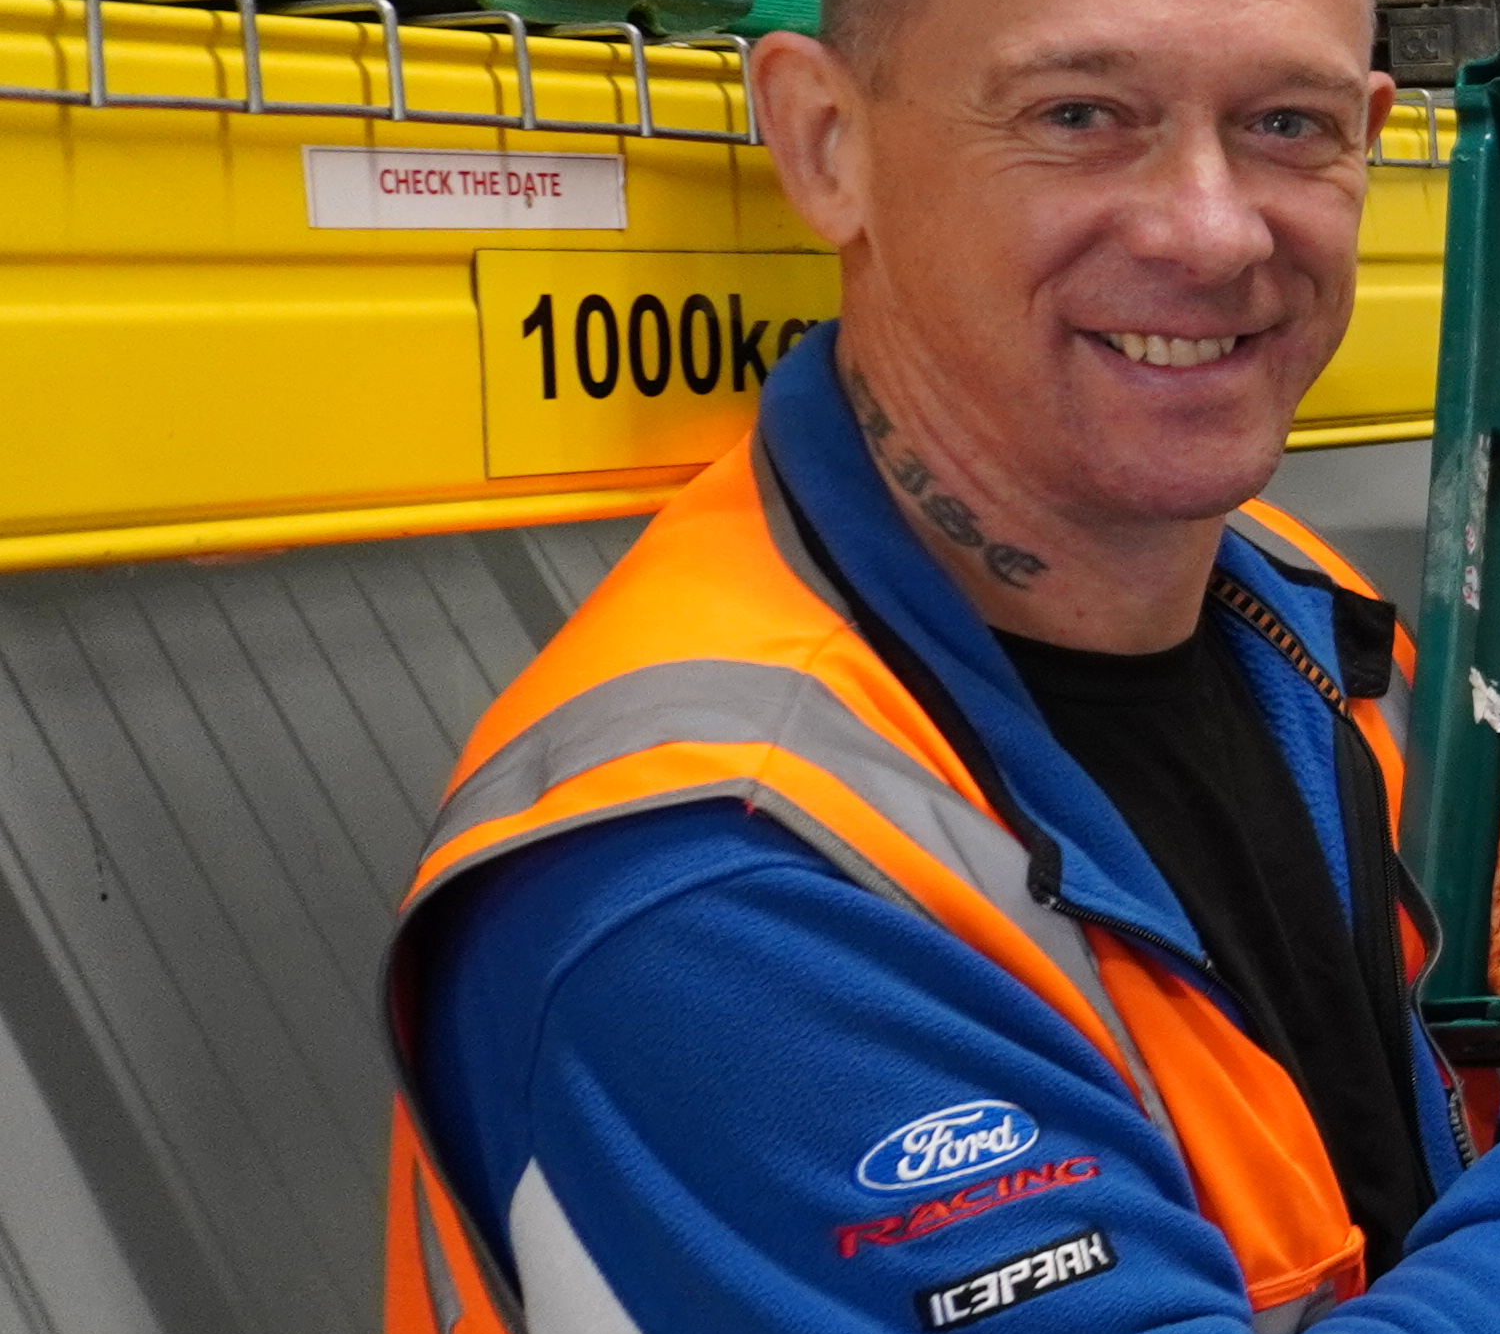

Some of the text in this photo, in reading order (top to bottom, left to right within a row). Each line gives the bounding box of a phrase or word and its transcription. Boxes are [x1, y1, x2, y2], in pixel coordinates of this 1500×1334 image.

[379, 169, 562, 197] CHECK THE DATE
[897, 1111, 1020, 1181] Ford
[834, 1156, 1100, 1259] RACING
